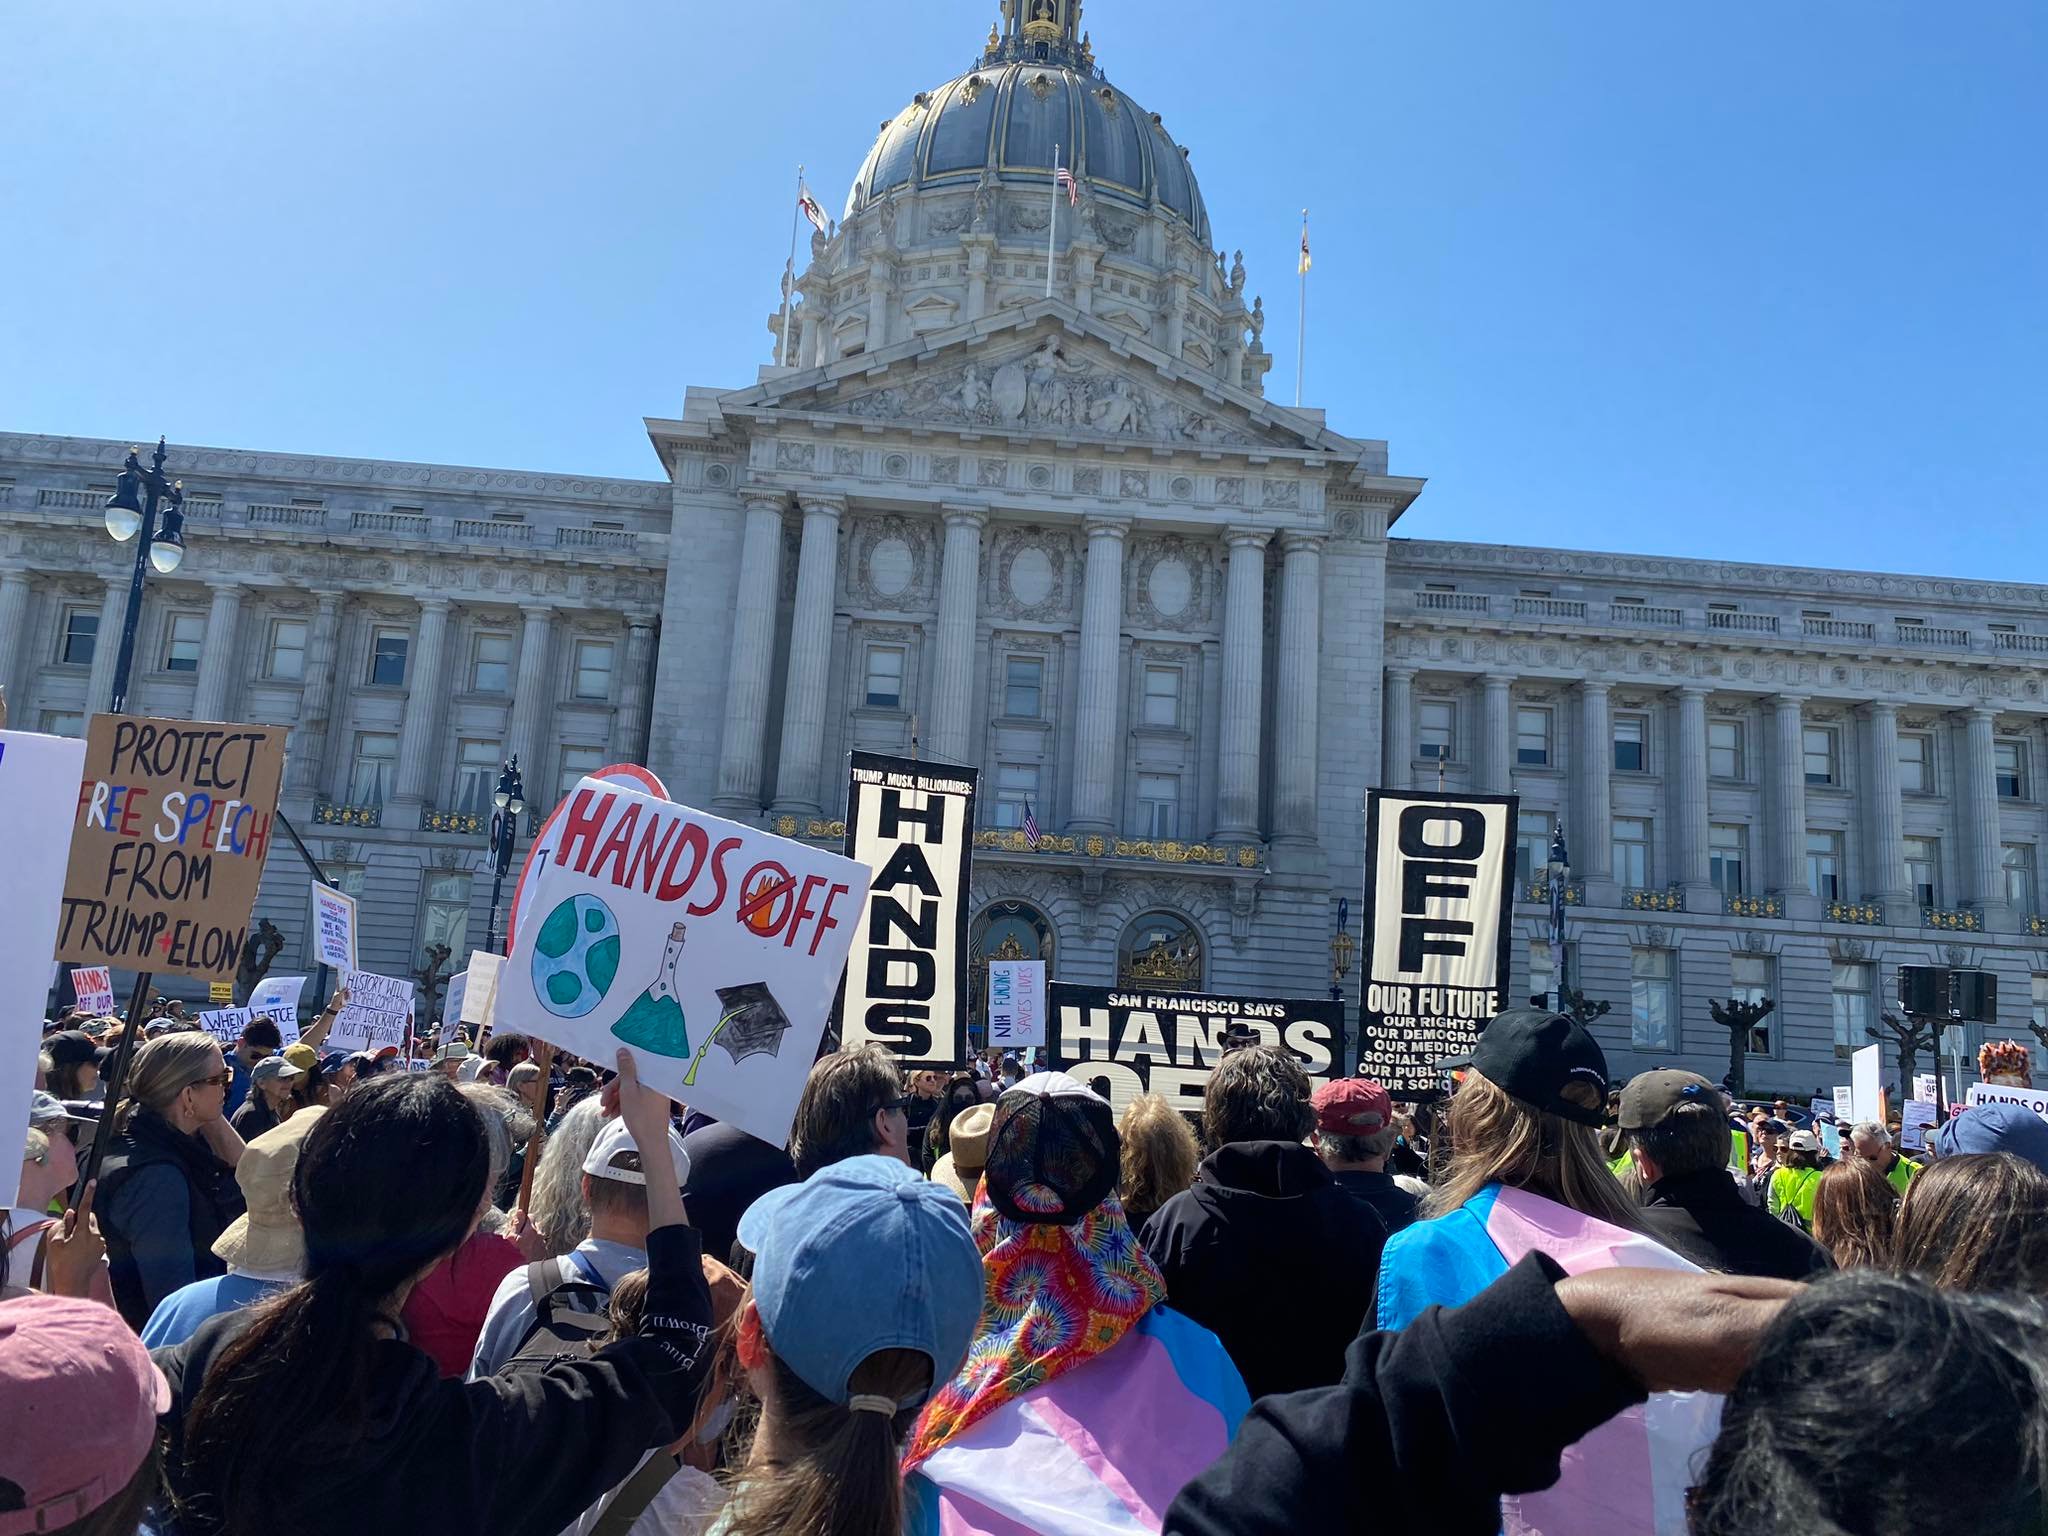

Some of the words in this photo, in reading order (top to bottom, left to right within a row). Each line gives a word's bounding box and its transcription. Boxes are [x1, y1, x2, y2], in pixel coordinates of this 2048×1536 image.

[110, 721, 267, 798] PROTECT
[852, 768, 886, 785] TRUMP,
[887, 772, 915, 789] MUSK,
[917, 776, 973, 795] BILLIONAIRES:
[75, 780, 149, 838] FREE
[153, 791, 269, 860] SPEECH
[104, 841, 212, 902] FROM
[555, 788, 742, 917] HANDS
[736, 860, 849, 957] OFF
[1398, 806, 1485, 973] OFF
[865, 788, 946, 1056] HANDS
[73, 970, 109, 995] HANDS
[346, 973, 385, 994] HISTORY
[386, 979, 405, 1000] WILL
[993, 970, 1011, 1006] FUNDING
[1017, 967, 1033, 994] LIVES
[97, 995, 112, 1009] OUR
[1108, 993, 1143, 1008] SAN
[1147, 996, 1239, 1015] FRANCISCO
[1244, 1002, 1286, 1018] SAYS
[1367, 984, 1411, 1015] OUR
[1418, 987, 1498, 1018] FUTURE
[203, 1011, 244, 1029] WHEN
[339, 1022, 357, 1037] NOT
[364, 1008, 403, 1030] IGNORANCE
[994, 1015, 1011, 1037] NIH
[1017, 999, 1033, 1035] SAVES
[1383, 1016, 1415, 1027] OUR
[1420, 1017, 1476, 1031] RIGHTS
[1366, 1026, 1399, 1039] OUR
[1364, 1051, 1420, 1065] SOCIAL
[1374, 1039, 1407, 1052] OUR
[1358, 1062, 1391, 1076] OUR
[1977, 1093, 2029, 1109] HANDS
